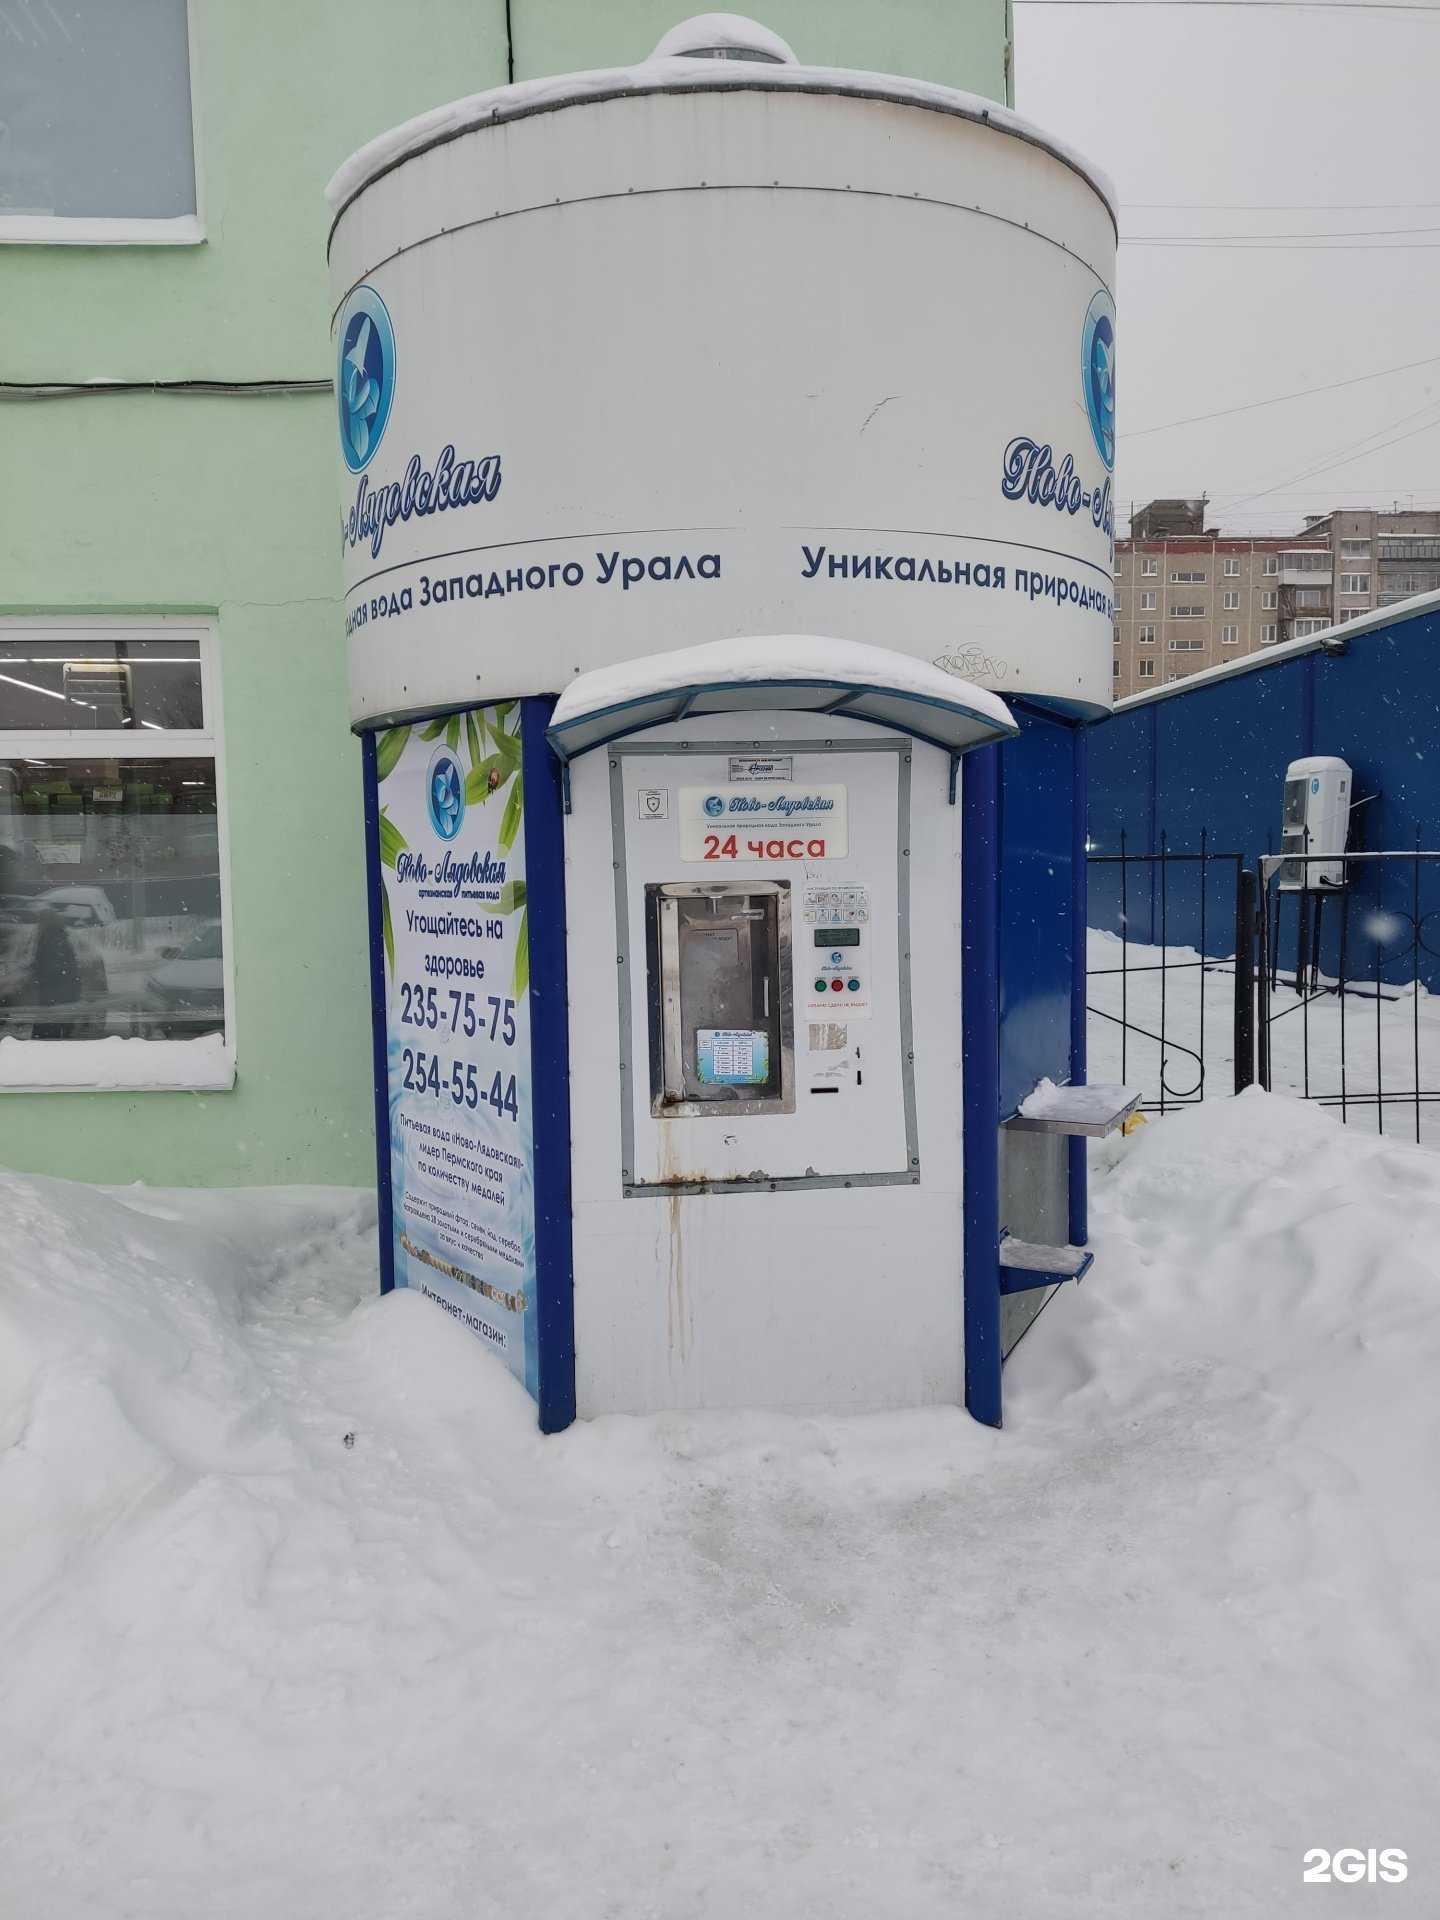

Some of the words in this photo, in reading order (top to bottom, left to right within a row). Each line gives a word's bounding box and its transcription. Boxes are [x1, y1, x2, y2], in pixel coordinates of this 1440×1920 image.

[340, 444, 501, 559] -Лядовская
[371, 586, 413, 621] вода
[419, 561, 584, 607] Западного
[596, 551, 722, 590] Урала
[801, 545, 1006, 590] Уникальная
[1015, 568, 1107, 617] природная
[728, 795, 834, 817] Ново-Лядовская
[704, 834, 738, 860] 24
[747, 839, 825, 859] часа
[396, 850, 506, 898] Ново-Лядовская
[406, 909, 483, 938] Угощайтесь
[487, 919, 503, 940] на
[425, 954, 485, 979] здоровье
[401, 982, 516, 1046] 235-75-75
[402, 1048, 518, 1122] 254-55-44
[400, 1113, 431, 1135] Питьевая
[432, 1127, 450, 1142] вода
[418, 1161, 426, 1171] по
[428, 1166, 470, 1192] количеству
[471, 1183, 505, 1206] медалей
[419, 1143, 440, 1160] лидер
[442, 1148, 483, 1175] Пермского
[484, 1167, 503, 1183] края
